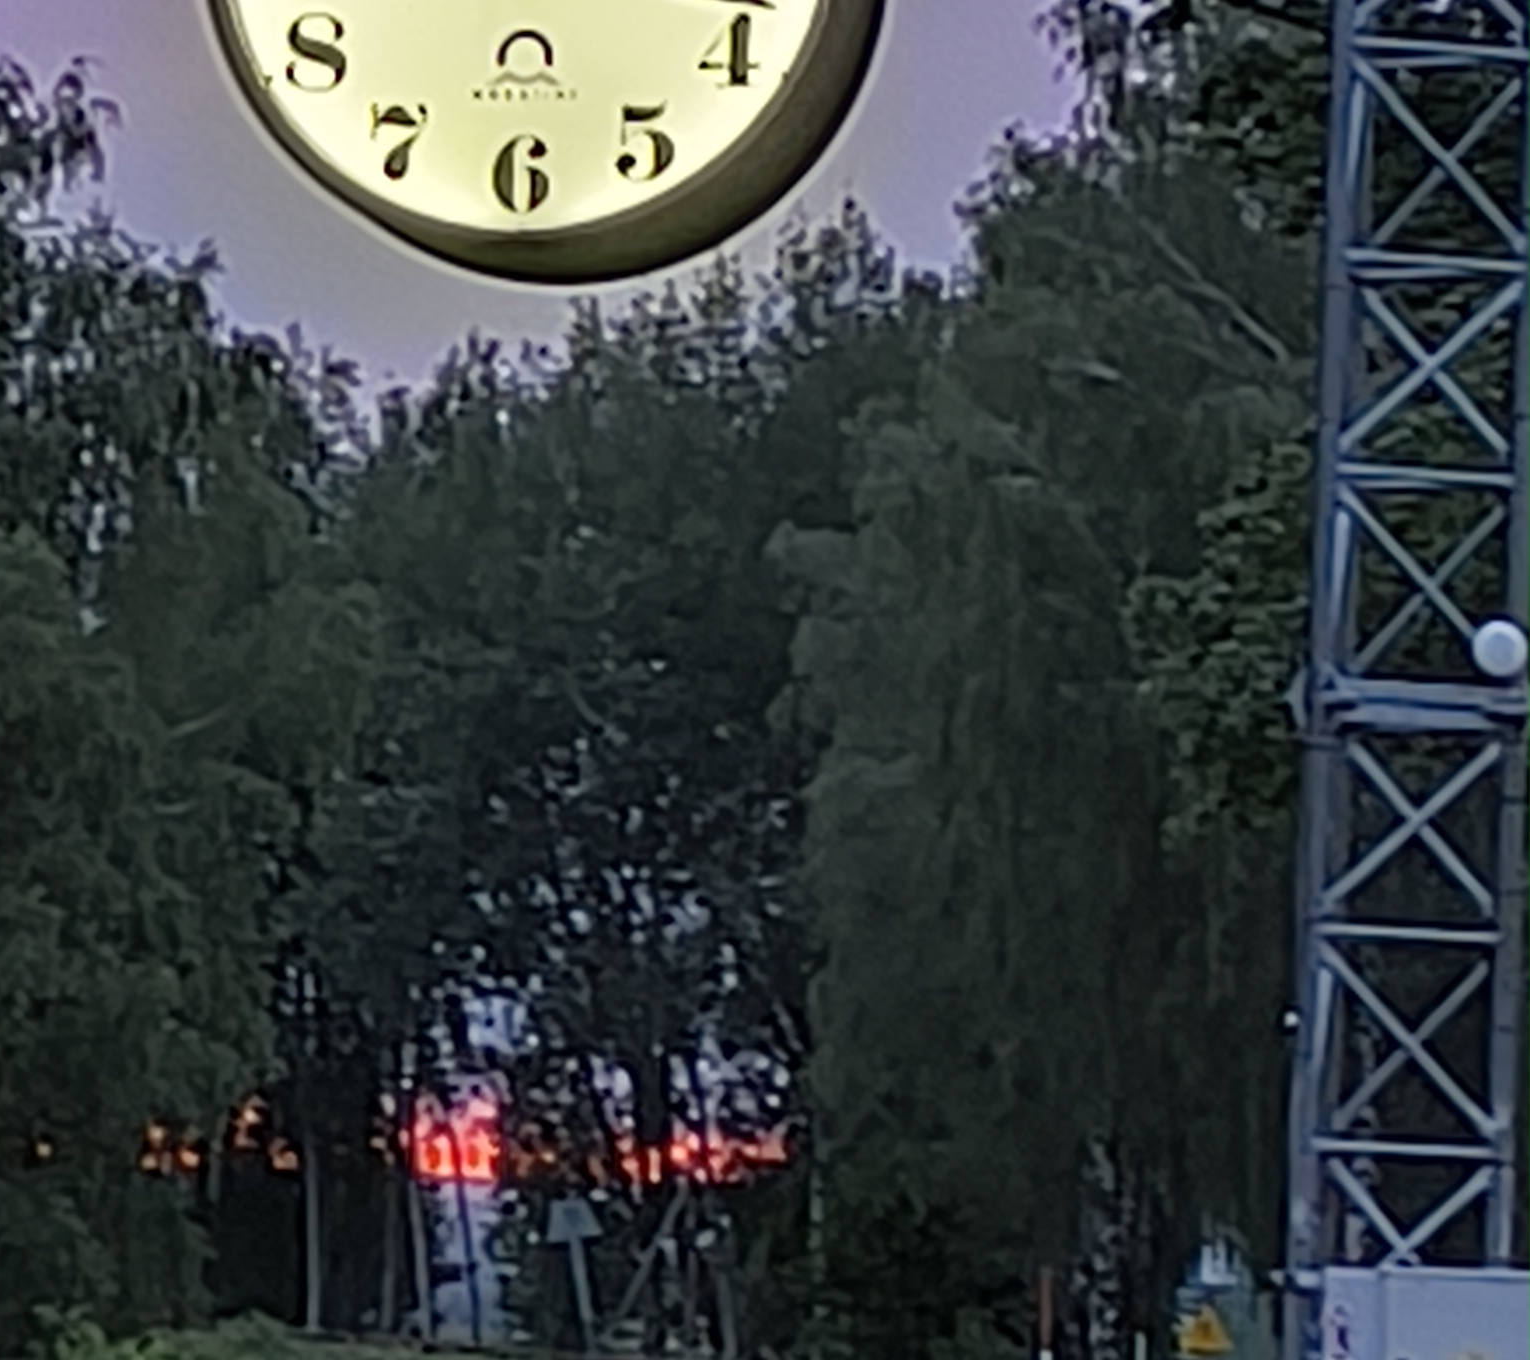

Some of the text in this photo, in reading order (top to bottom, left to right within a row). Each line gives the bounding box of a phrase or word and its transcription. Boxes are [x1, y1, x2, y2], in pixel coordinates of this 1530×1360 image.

[285, 12, 348, 93] 8
[697, 12, 760, 88] 4
[370, 102, 428, 181] 7
[492, 134, 550, 215] 6
[614, 102, 676, 183] 5
